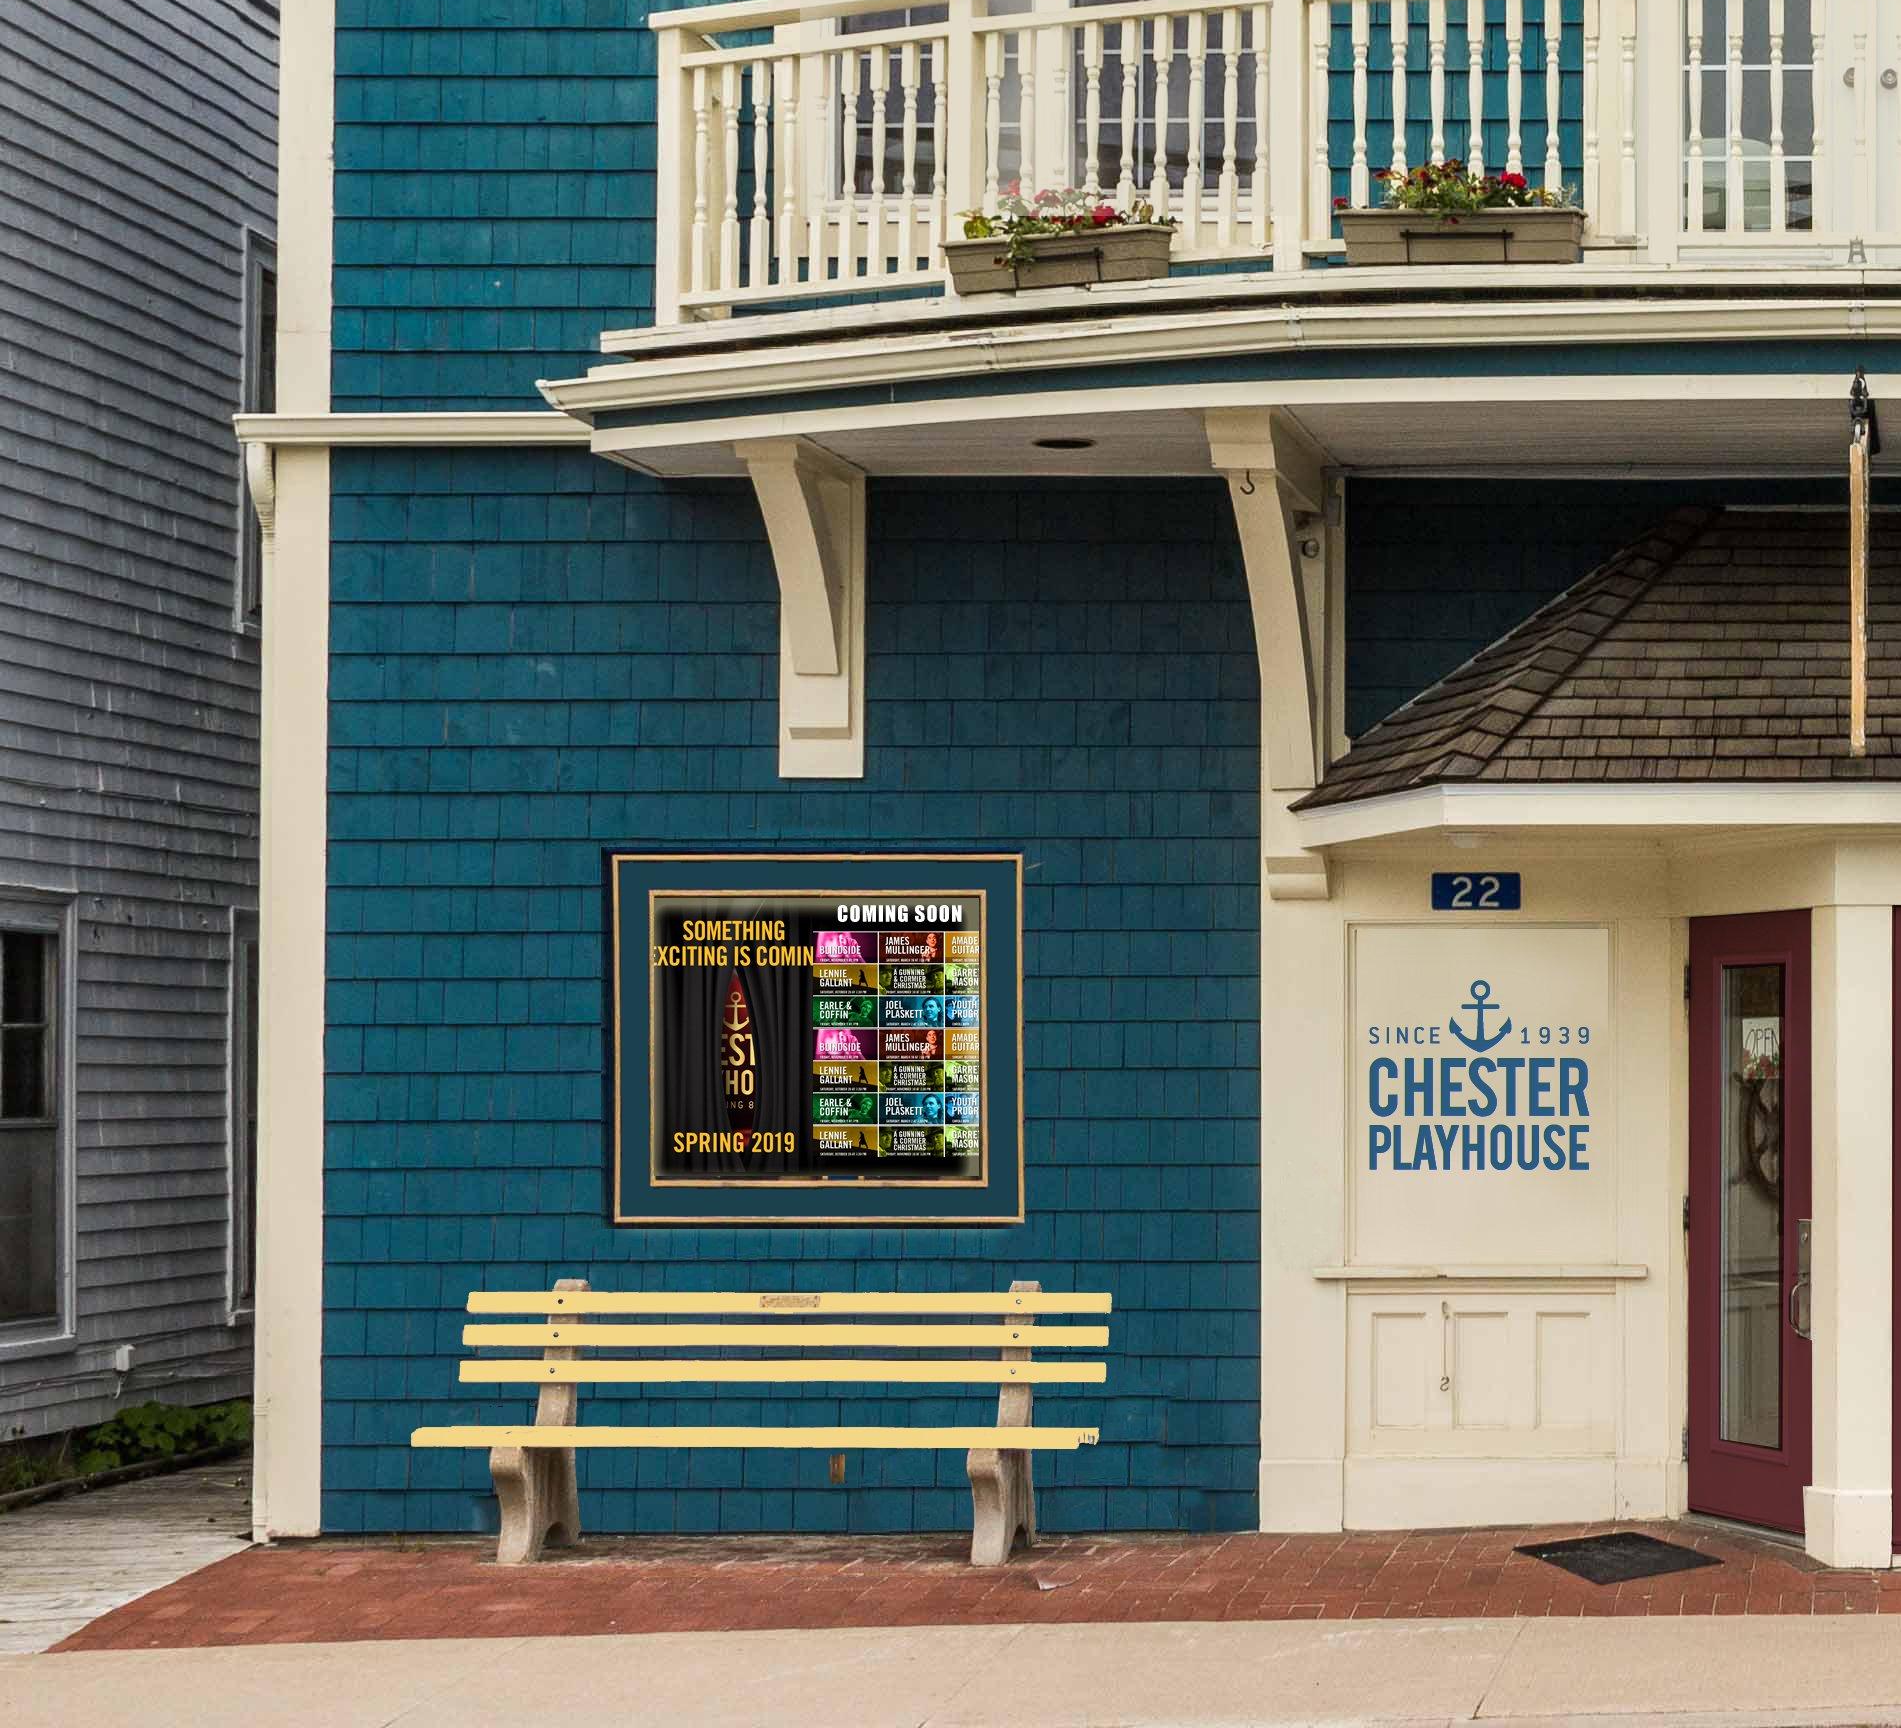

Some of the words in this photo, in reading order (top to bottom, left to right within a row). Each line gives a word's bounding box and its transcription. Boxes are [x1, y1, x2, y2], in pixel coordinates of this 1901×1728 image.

[1451, 876, 1500, 907] 22
[837, 904, 909, 923] COMING
[914, 904, 963, 923] SOON
[682, 920, 785, 941] SOMETHING
[885, 937, 909, 945] JAMES
[886, 945, 930, 954] MULLINGER
[952, 945, 979, 954] GUITAR
[734, 945, 751, 967] IS
[756, 945, 813, 967] COMIN
[820, 969, 847, 977] LENNIE
[952, 969, 979, 977] GARRE
[820, 978, 853, 987] GALLANT
[952, 978, 978, 987] MASON
[820, 1001, 843, 1010] EARLE
[846, 1001, 852, 1010] &
[885, 1001, 903, 1009] JOEL
[952, 1001, 977, 1009] YOUTH
[820, 1010, 849, 1019] COFFIN
[886, 1010, 923, 1018] PLASKETT
[885, 1034, 909, 1042] JAMES
[1369, 1026, 1440, 1045] SINCE
[1520, 1026, 1590, 1045] 1939
[886, 1042, 930, 1051] MULLINGER
[952, 1042, 979, 1051] GUITAR
[820, 1066, 847, 1074] LENNIE
[952, 1065, 979, 1074] GARRE
[820, 1075, 853, 1084] GALLANT
[952, 1075, 978, 1084] MASON
[1369, 1057, 1590, 1117] CHESTER
[820, 1098, 843, 1107] EARLE
[846, 1098, 852, 1107] &
[885, 1097, 903, 1106] JOEL
[952, 1097, 977, 1106] YOUTH
[820, 1107, 849, 1116] COFFIN
[886, 1107, 923, 1115] PLASKETT
[820, 1131, 847, 1140] LENNIE
[952, 1131, 979, 1139] GARRE
[673, 1132, 744, 1153] SPRING
[752, 1132, 795, 1153] 2019
[820, 1140, 853, 1149] GALLANT
[952, 1140, 978, 1149] MASON
[1369, 1124, 1590, 1171] PLAYHOUSE
